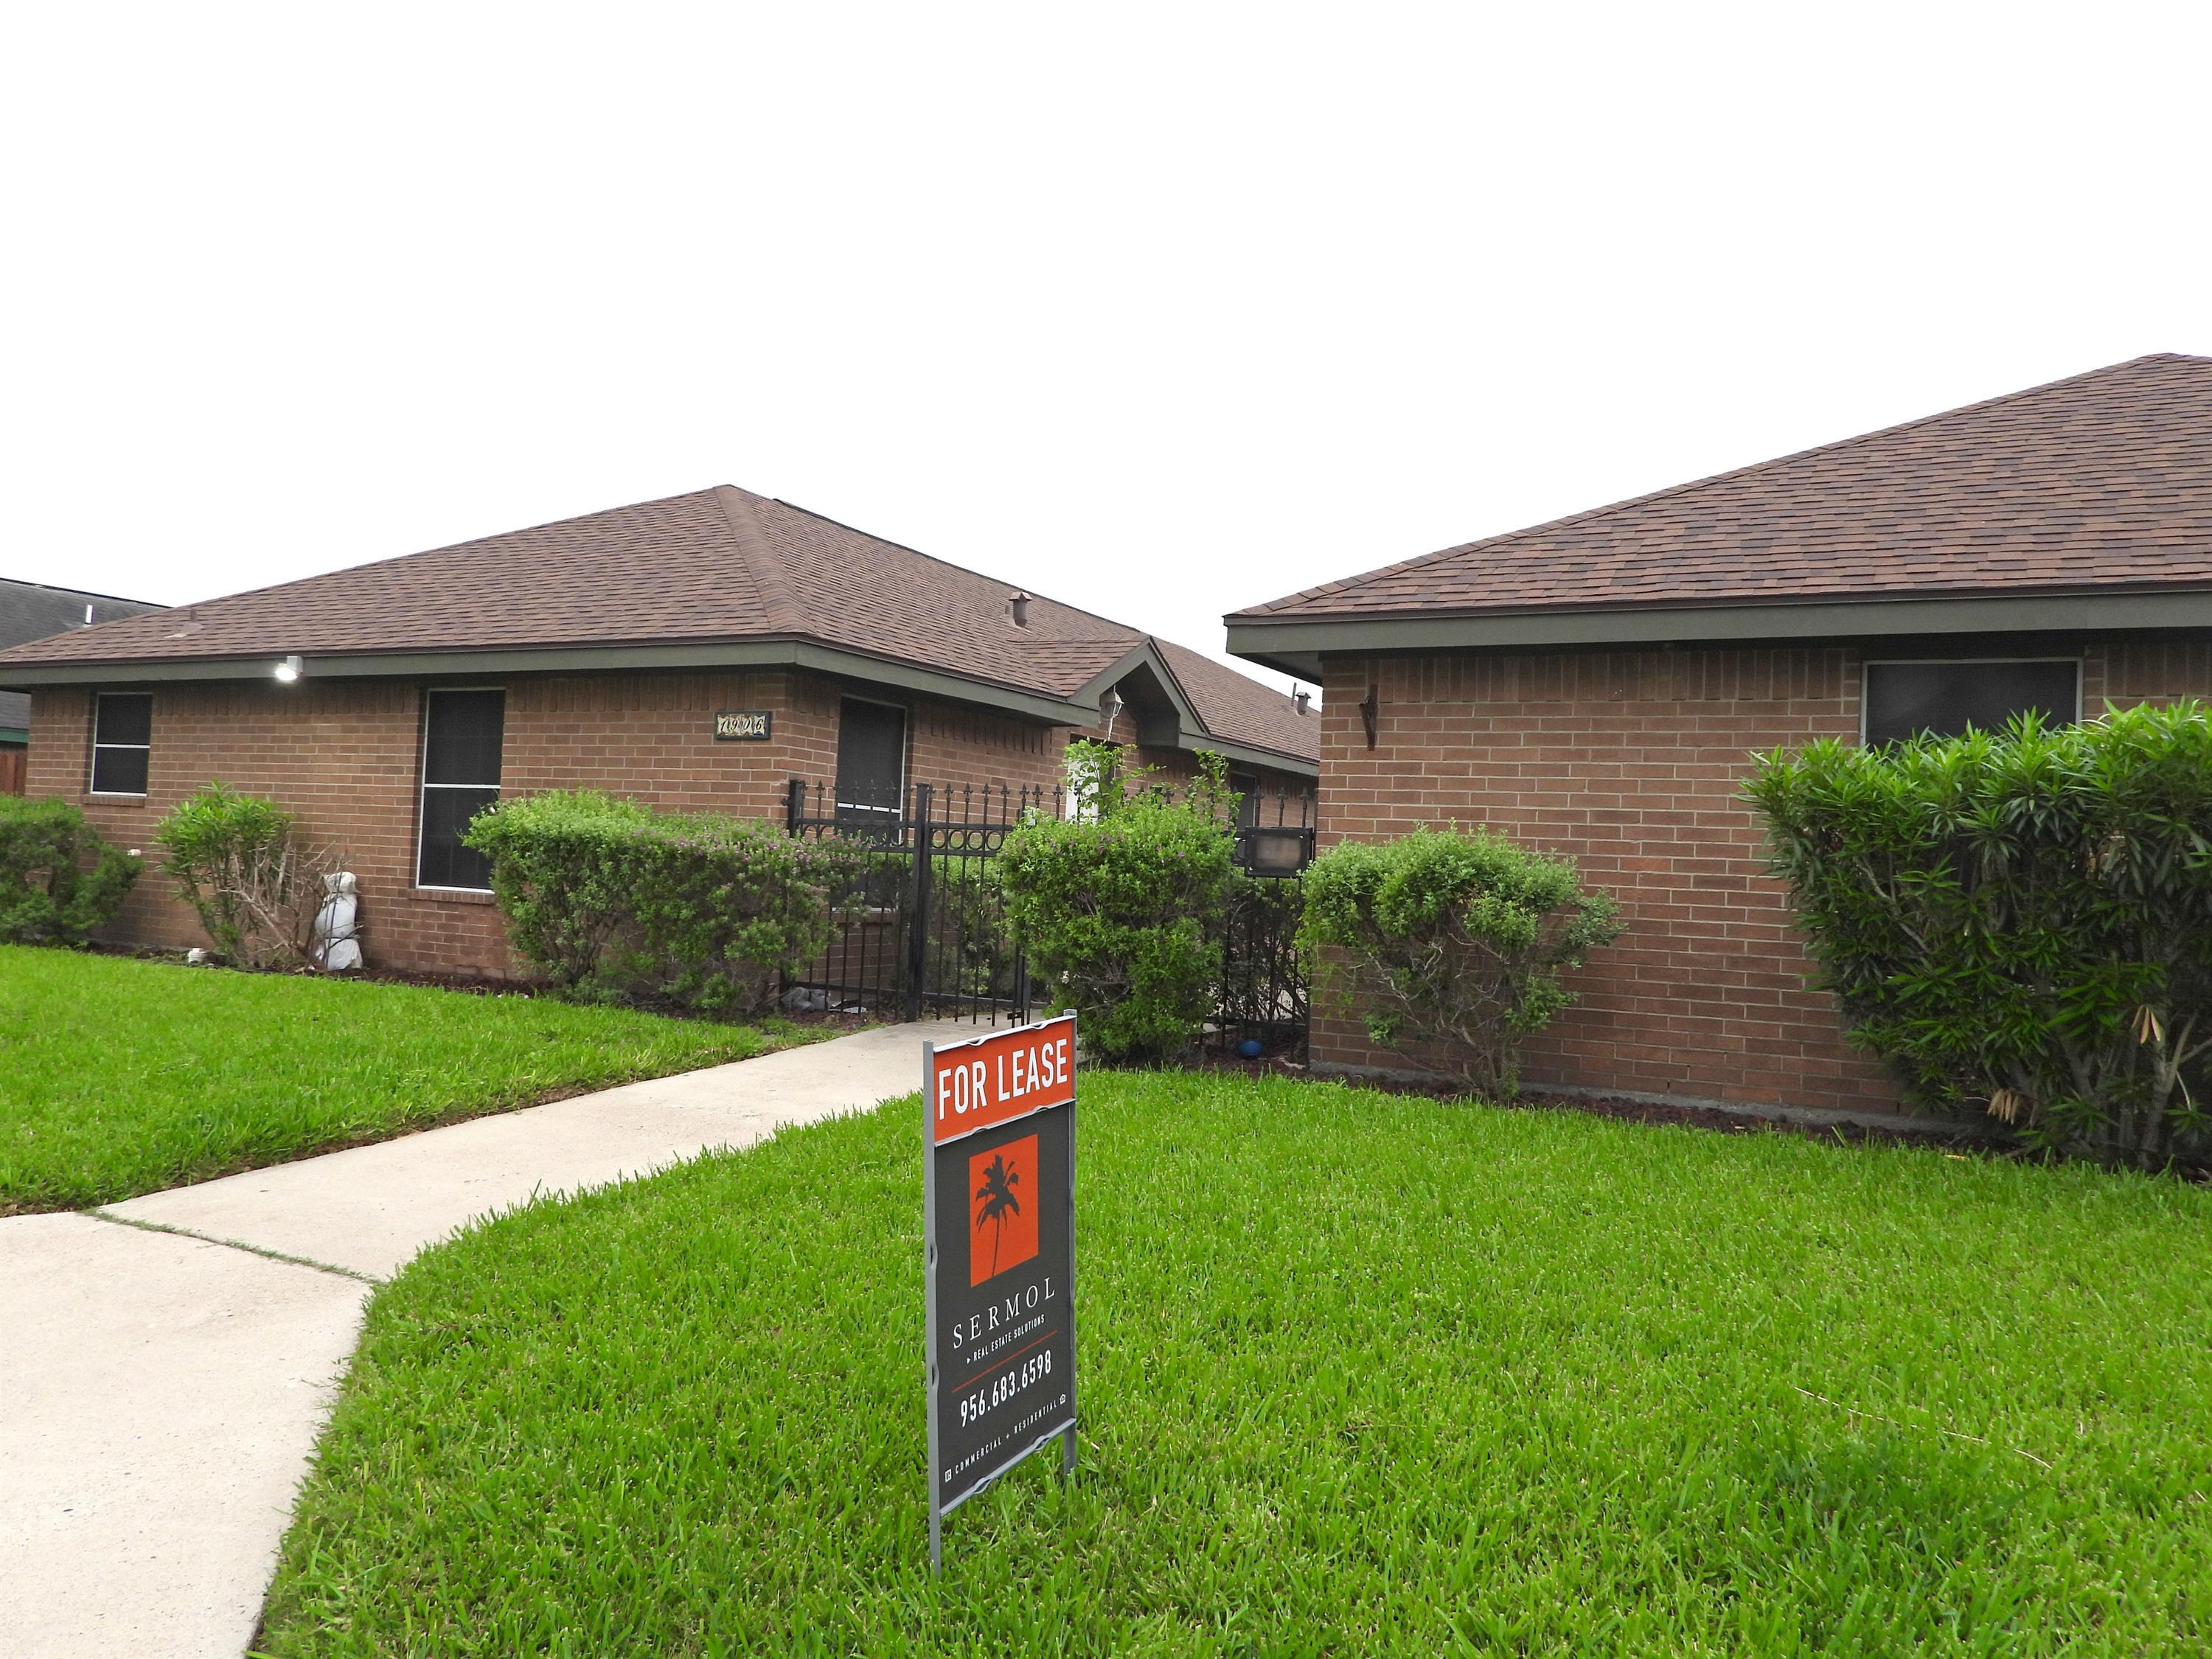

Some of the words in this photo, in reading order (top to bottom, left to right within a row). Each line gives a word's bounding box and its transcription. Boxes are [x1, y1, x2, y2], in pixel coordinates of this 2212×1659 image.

[720, 719, 763, 731] 1906
[939, 1060, 987, 1120] FOR
[998, 1038, 1068, 1102] LEASE
[953, 1277, 1055, 1349] SERMOL
[973, 1346, 989, 1361] REAL
[991, 1332, 1012, 1352] ESTATE
[1014, 1314, 1045, 1338] SOLUTIONS
[961, 1349, 1051, 1427] 956.683.6598
[955, 1437, 1001, 1474] COMMERCIAL
[1014, 1400, 1057, 1434] RESIDENTIAL
